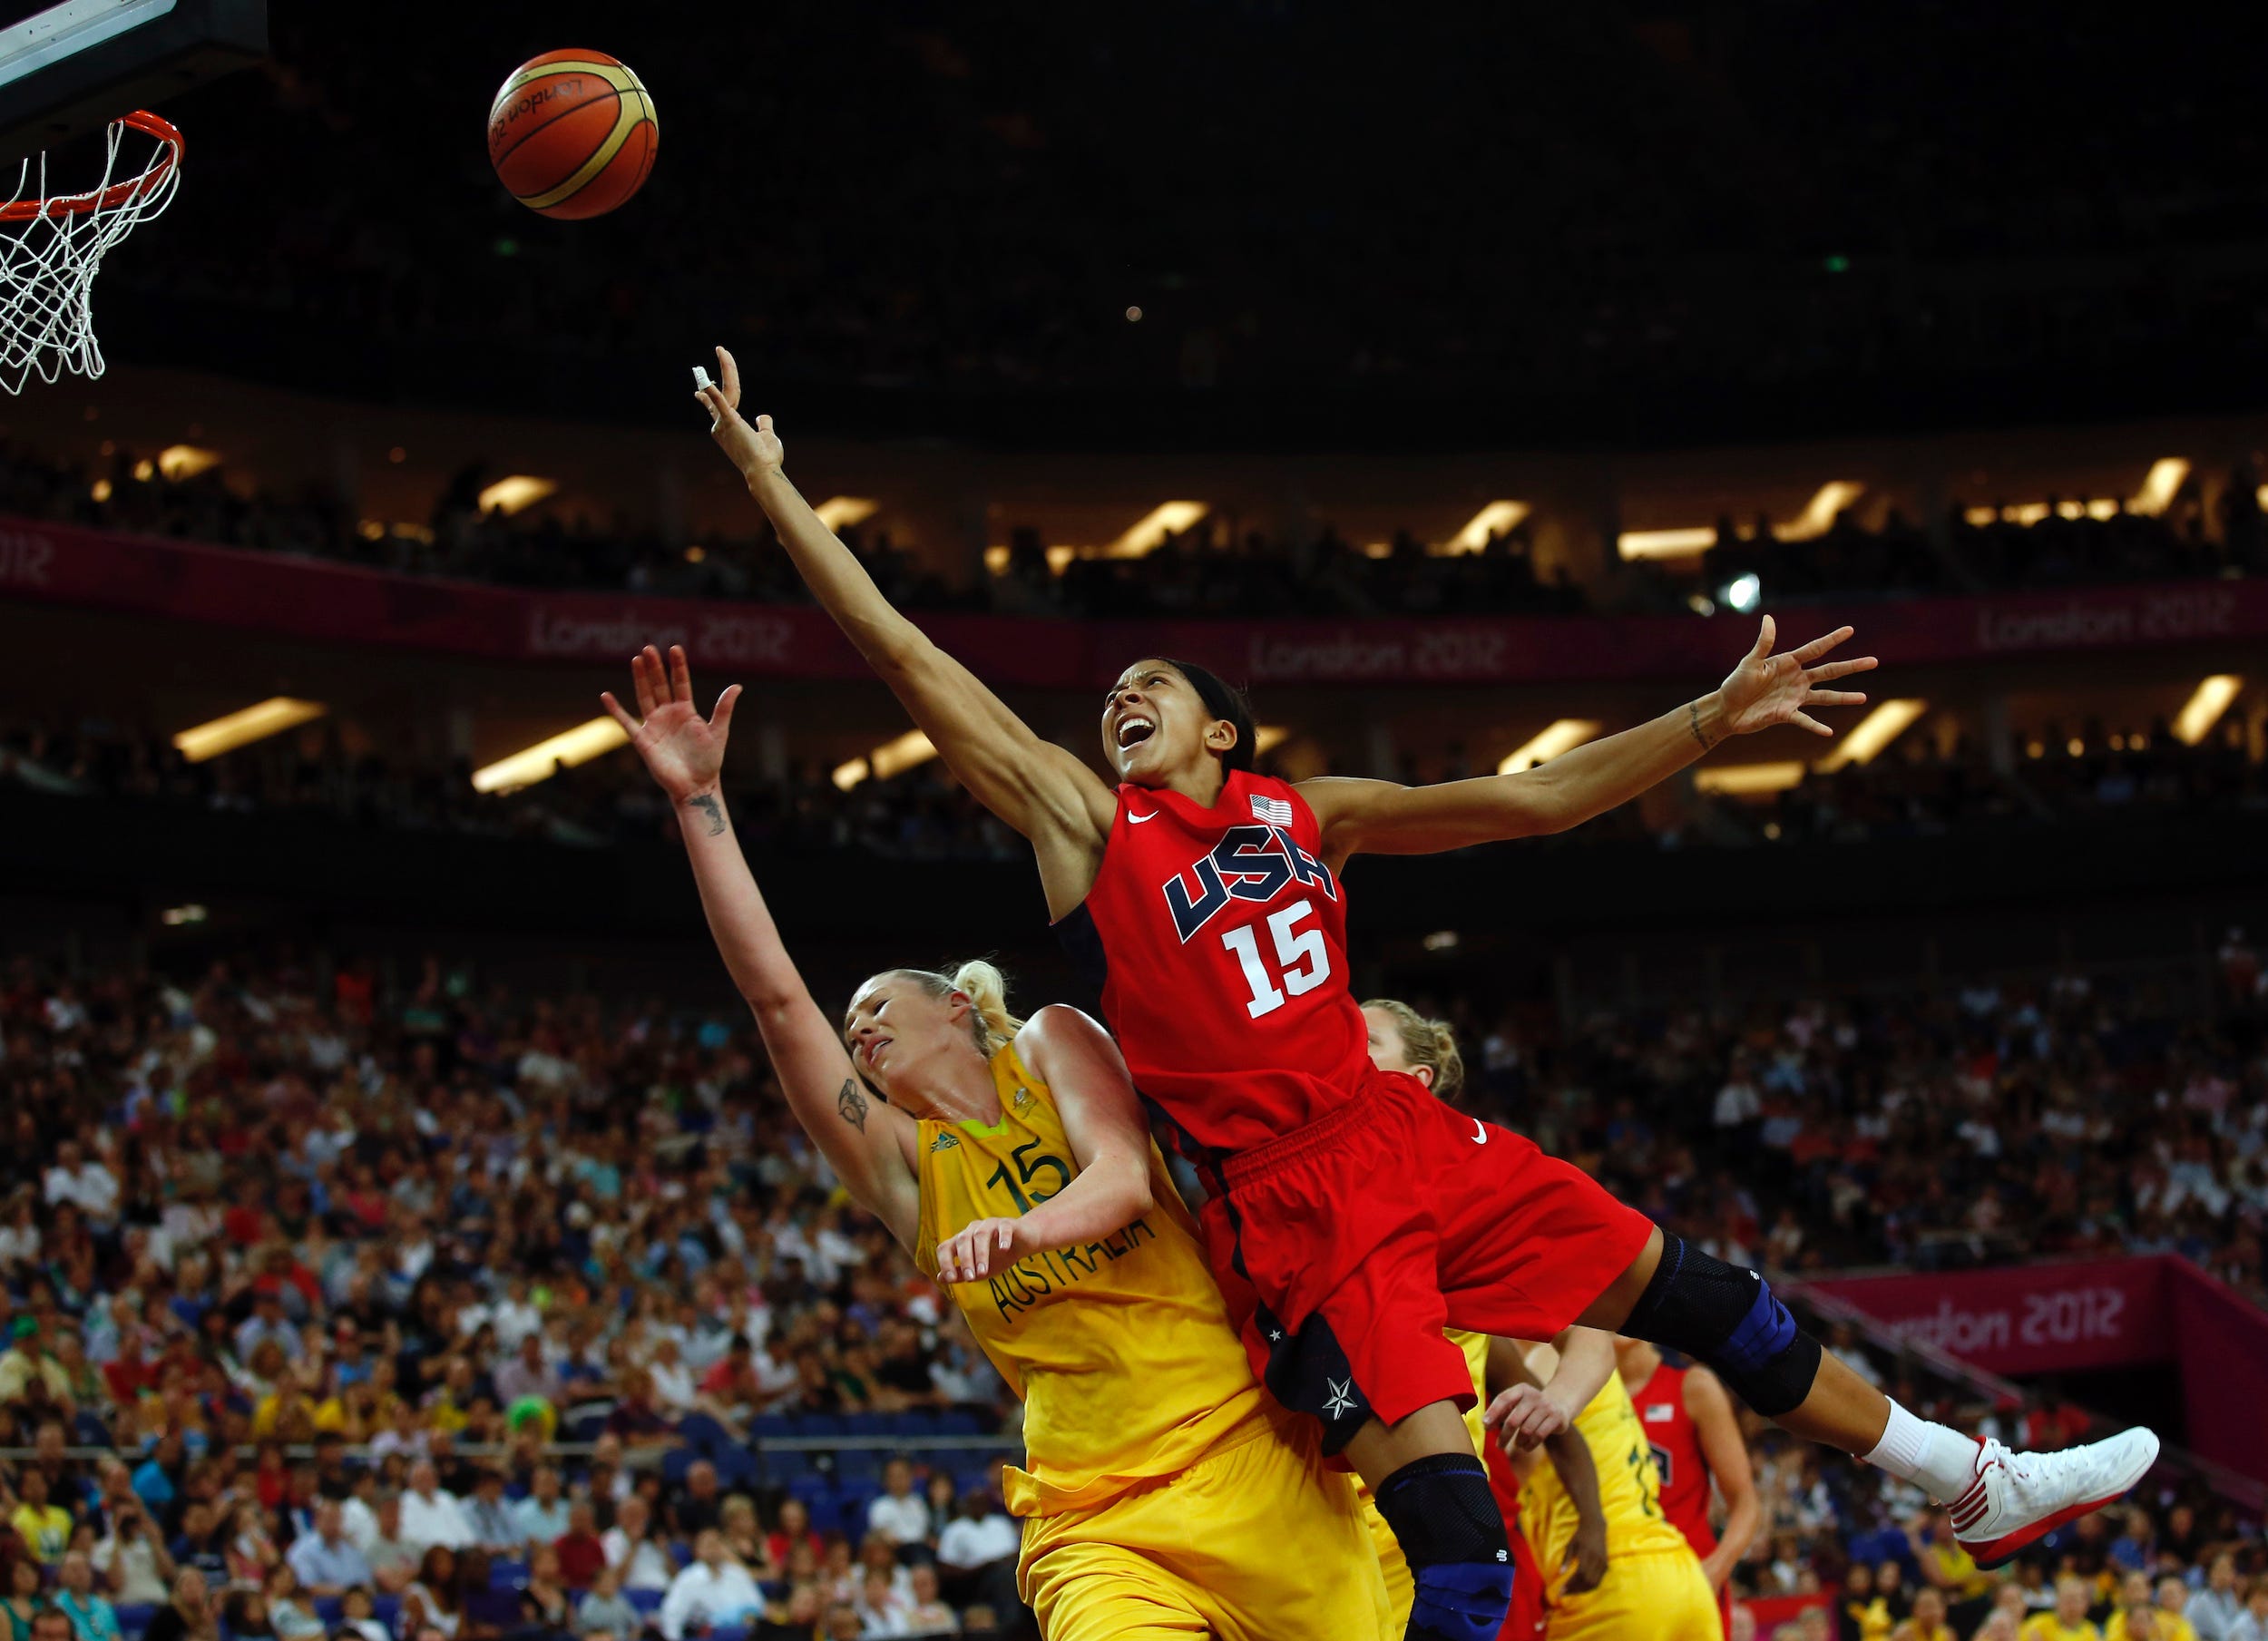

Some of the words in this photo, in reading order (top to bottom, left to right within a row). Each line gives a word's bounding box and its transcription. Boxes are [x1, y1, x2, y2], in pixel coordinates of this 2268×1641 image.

[509, 79, 583, 122] London
[530, 604, 688, 653] London
[697, 617, 795, 666] 2012
[1977, 595, 2132, 650] London
[2136, 590, 2235, 637] 2012
[1250, 630, 1403, 675] London
[1411, 628, 1505, 673] 2012
[1162, 825, 1337, 944] USA
[1221, 899, 1331, 1020] 15
[986, 1136, 1071, 1215] 15
[2021, 1286, 2125, 1344] 2012
